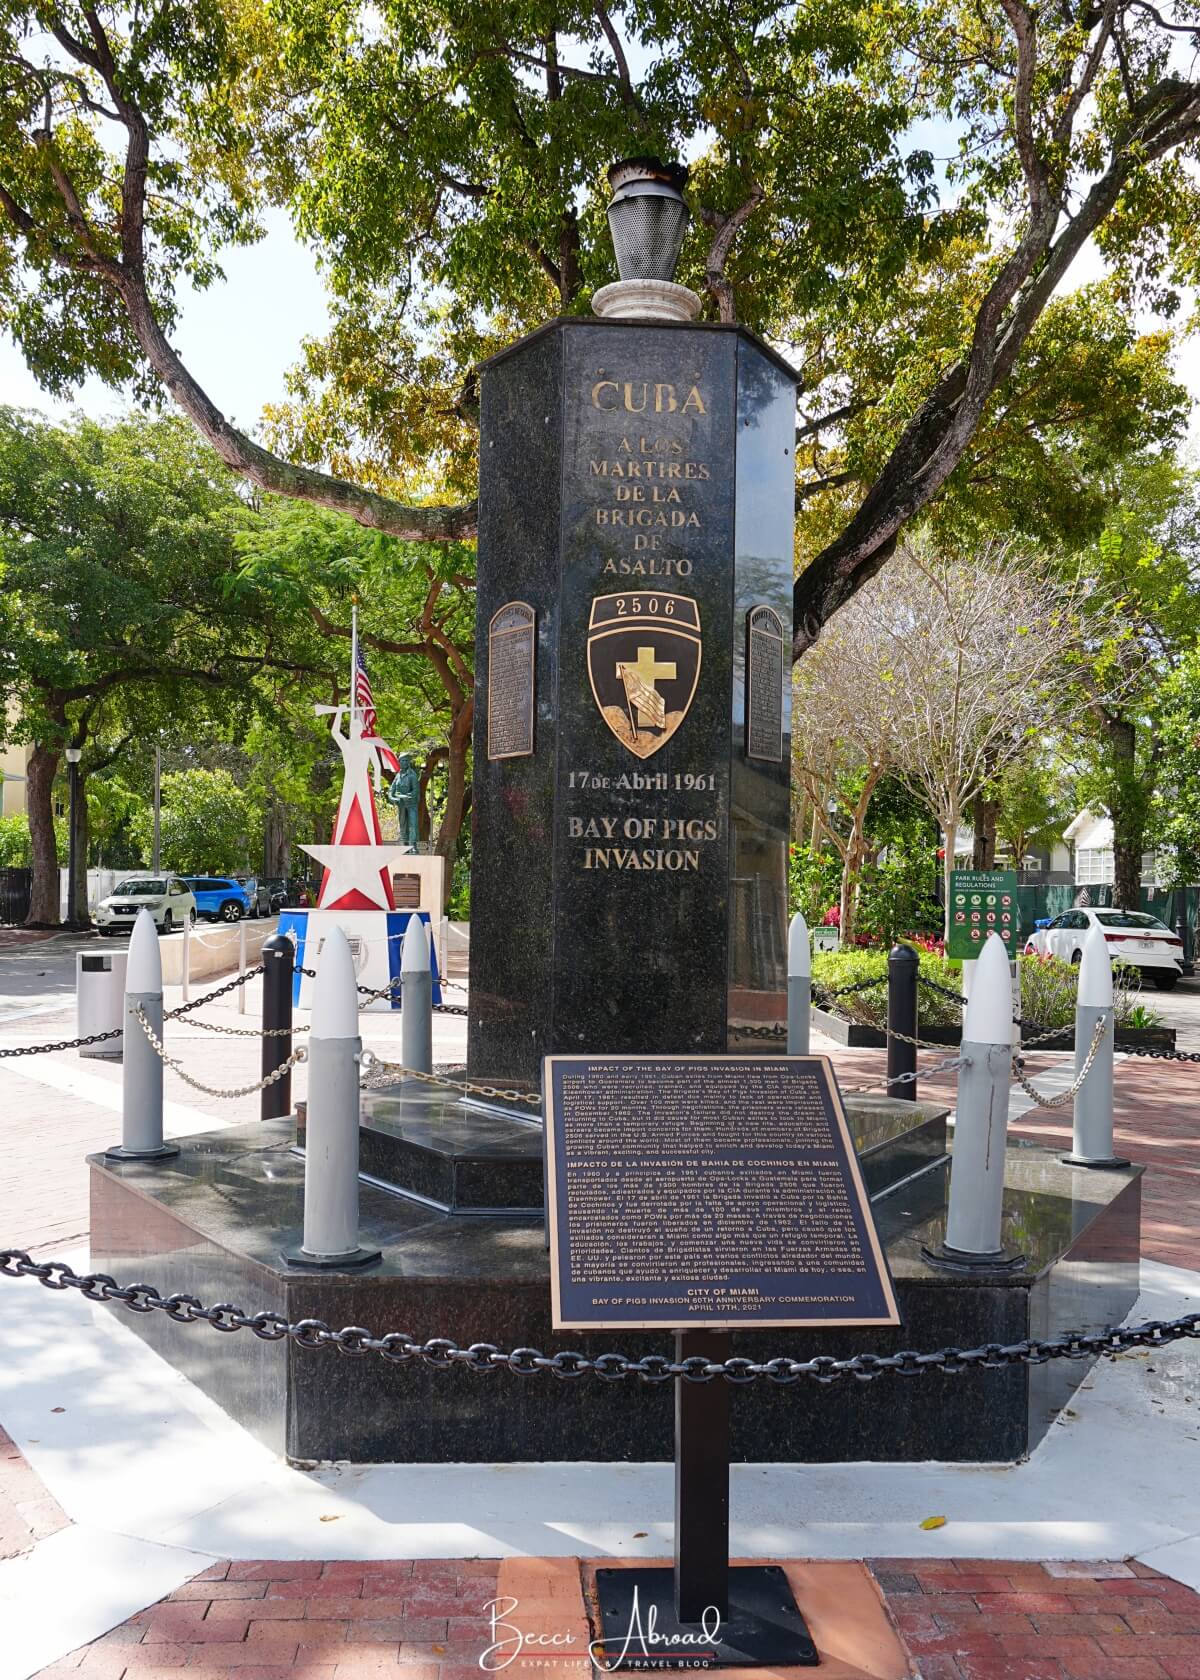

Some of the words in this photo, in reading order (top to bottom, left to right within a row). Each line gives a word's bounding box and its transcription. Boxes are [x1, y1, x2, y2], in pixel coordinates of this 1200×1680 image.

[591, 380, 706, 414] CUBA
[618, 437, 632, 453] A
[640, 437, 683, 454] LOS
[589, 460, 711, 480] MARTIRES
[616, 485, 644, 501] DE
[653, 486, 680, 502] LA
[596, 508, 701, 528] BRIGADA
[634, 534, 663, 550] DE
[603, 558, 693, 576] ASALTO
[616, 597, 675, 616] 2506
[615, 772, 668, 791] Abril
[674, 772, 715, 791] 1961
[567, 816, 618, 838] BAY
[623, 818, 657, 840] OF
[662, 818, 717, 841] PIGS
[583, 848, 701, 872] INVASION
